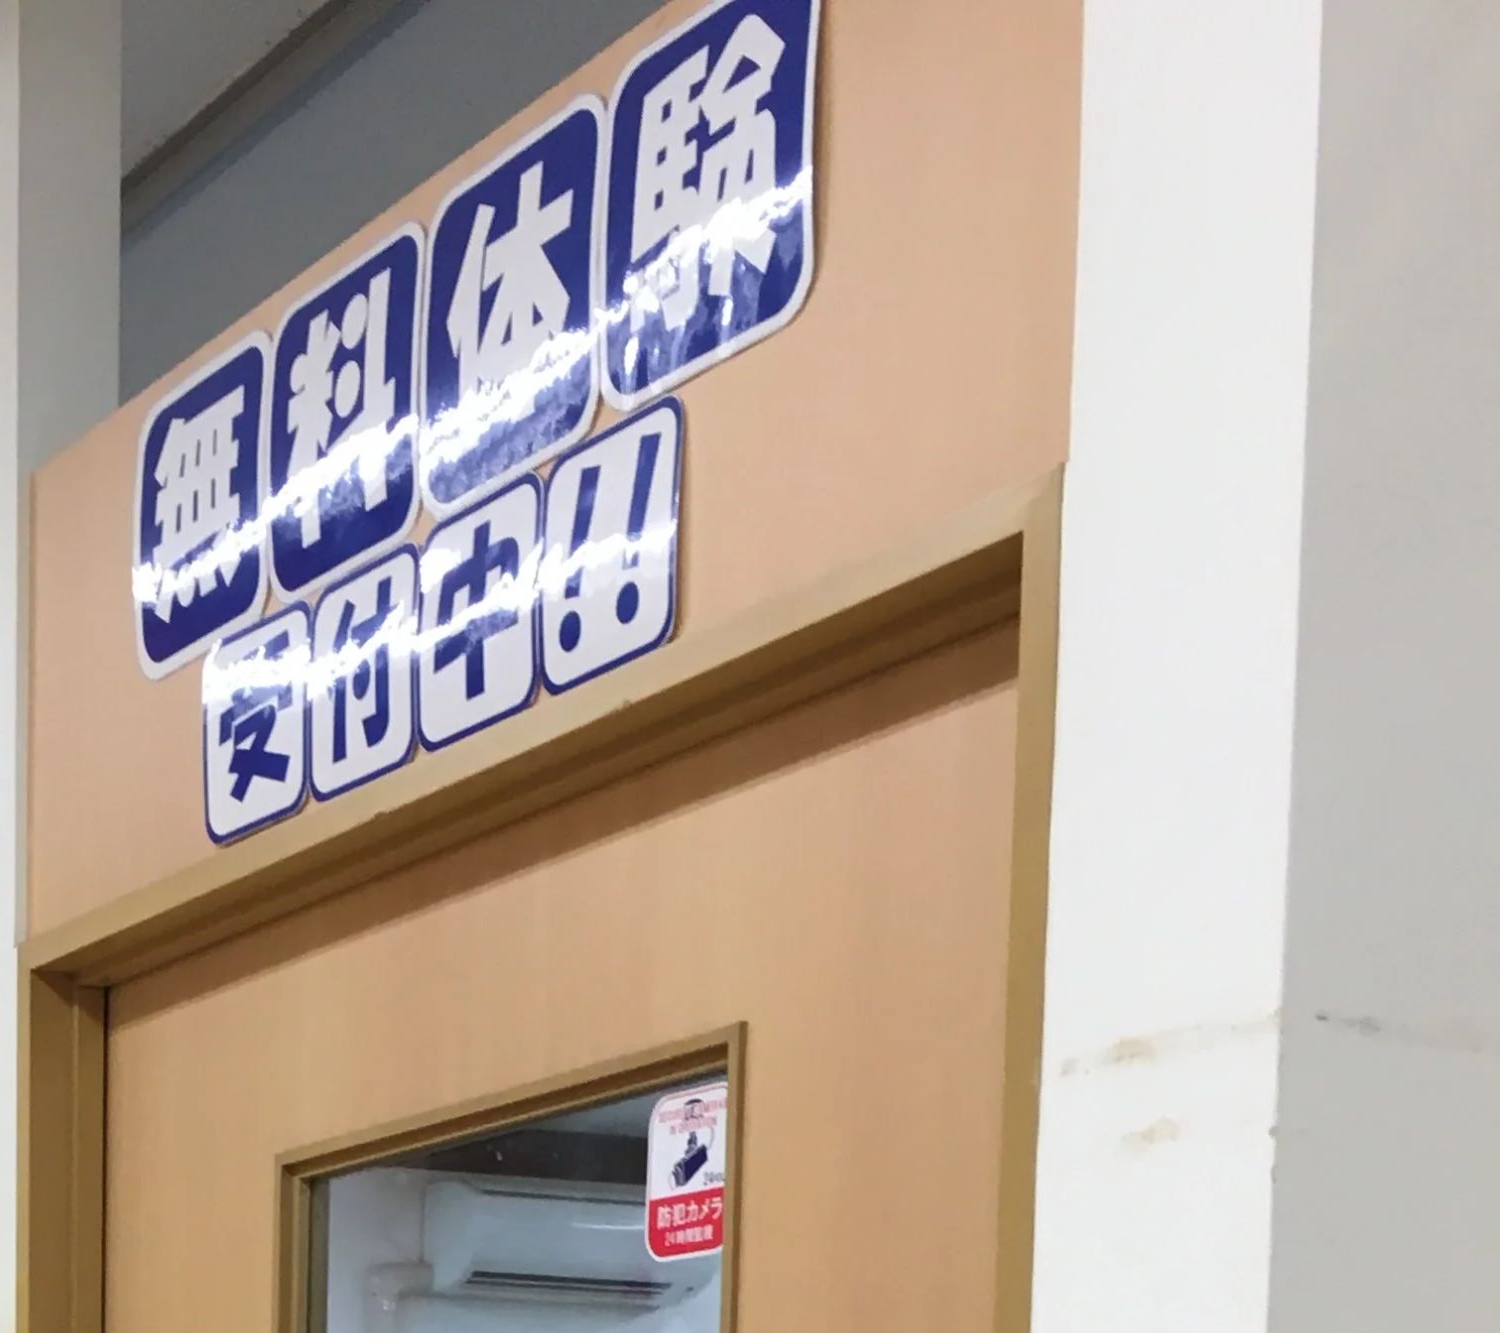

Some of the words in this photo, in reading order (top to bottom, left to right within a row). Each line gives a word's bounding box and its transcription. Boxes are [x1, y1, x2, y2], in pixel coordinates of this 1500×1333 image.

[657, 1197, 723, 1230] 防犯カメラ
